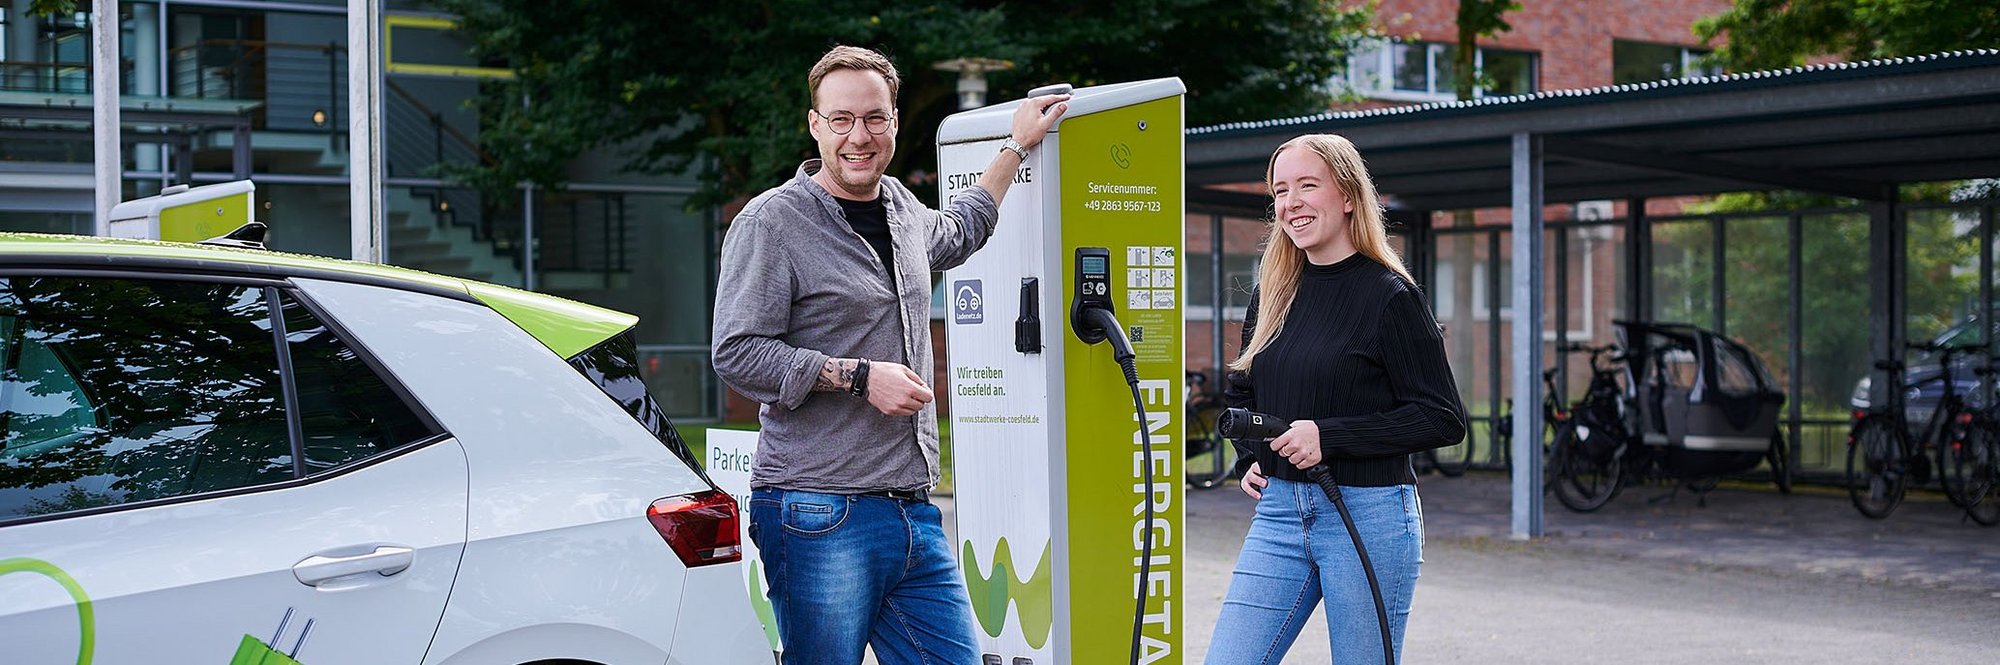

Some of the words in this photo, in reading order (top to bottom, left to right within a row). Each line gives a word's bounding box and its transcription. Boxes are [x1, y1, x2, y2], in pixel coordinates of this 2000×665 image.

[1088, 182, 1157, 194] Servicenummer:
[1085, 200, 1100, 210] +49
[1102, 200, 1122, 211] 2863
[1123, 201, 1161, 211] 9567-123
[957, 367, 972, 379] Wir
[974, 367, 1003, 379] treiben
[957, 384, 992, 396] Coesfeld
[993, 386, 1006, 396] an.
[959, 414, 1040, 424] www.stadtwerke-coesfeld.de
[713, 446, 753, 473] Parke
[1133, 379, 1171, 665] ENERGIETA
